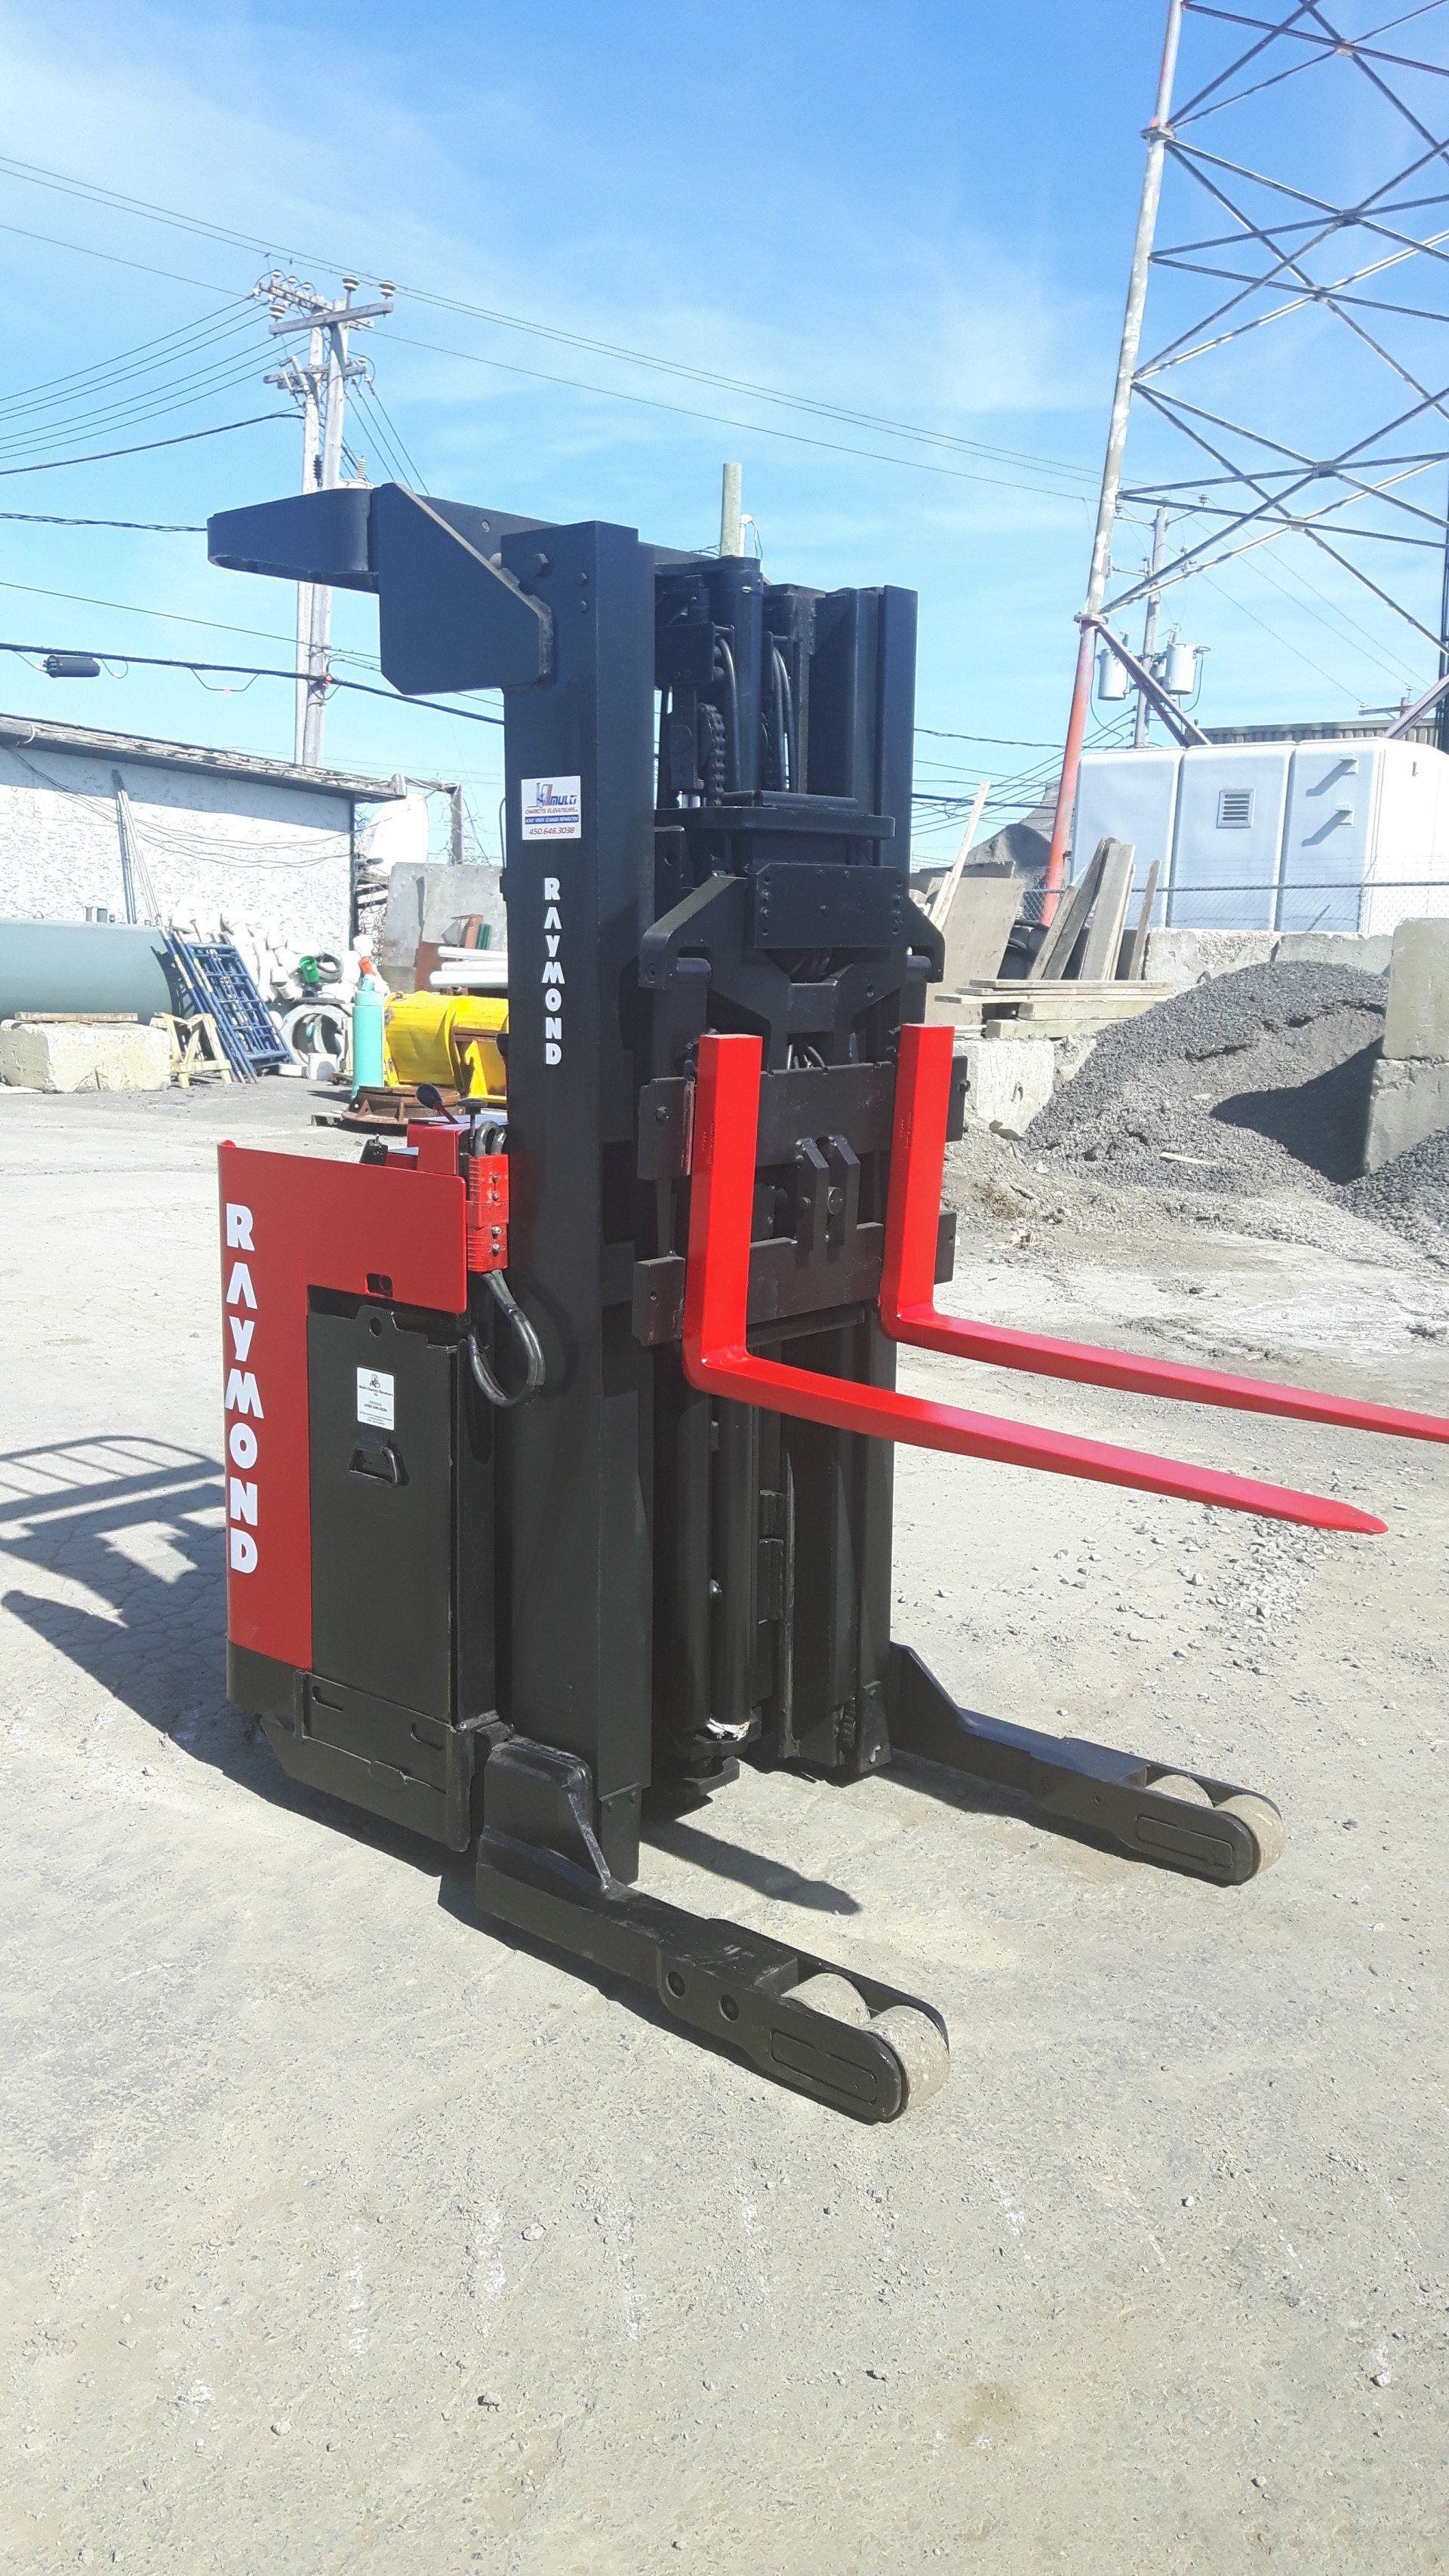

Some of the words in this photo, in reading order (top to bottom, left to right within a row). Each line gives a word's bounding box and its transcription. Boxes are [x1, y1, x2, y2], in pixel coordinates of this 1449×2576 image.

[529, 826, 575, 835] 450.646.3038
[541, 877, 565, 1065] RAYMOND
[225, 1202, 264, 1574] RAYMOND
